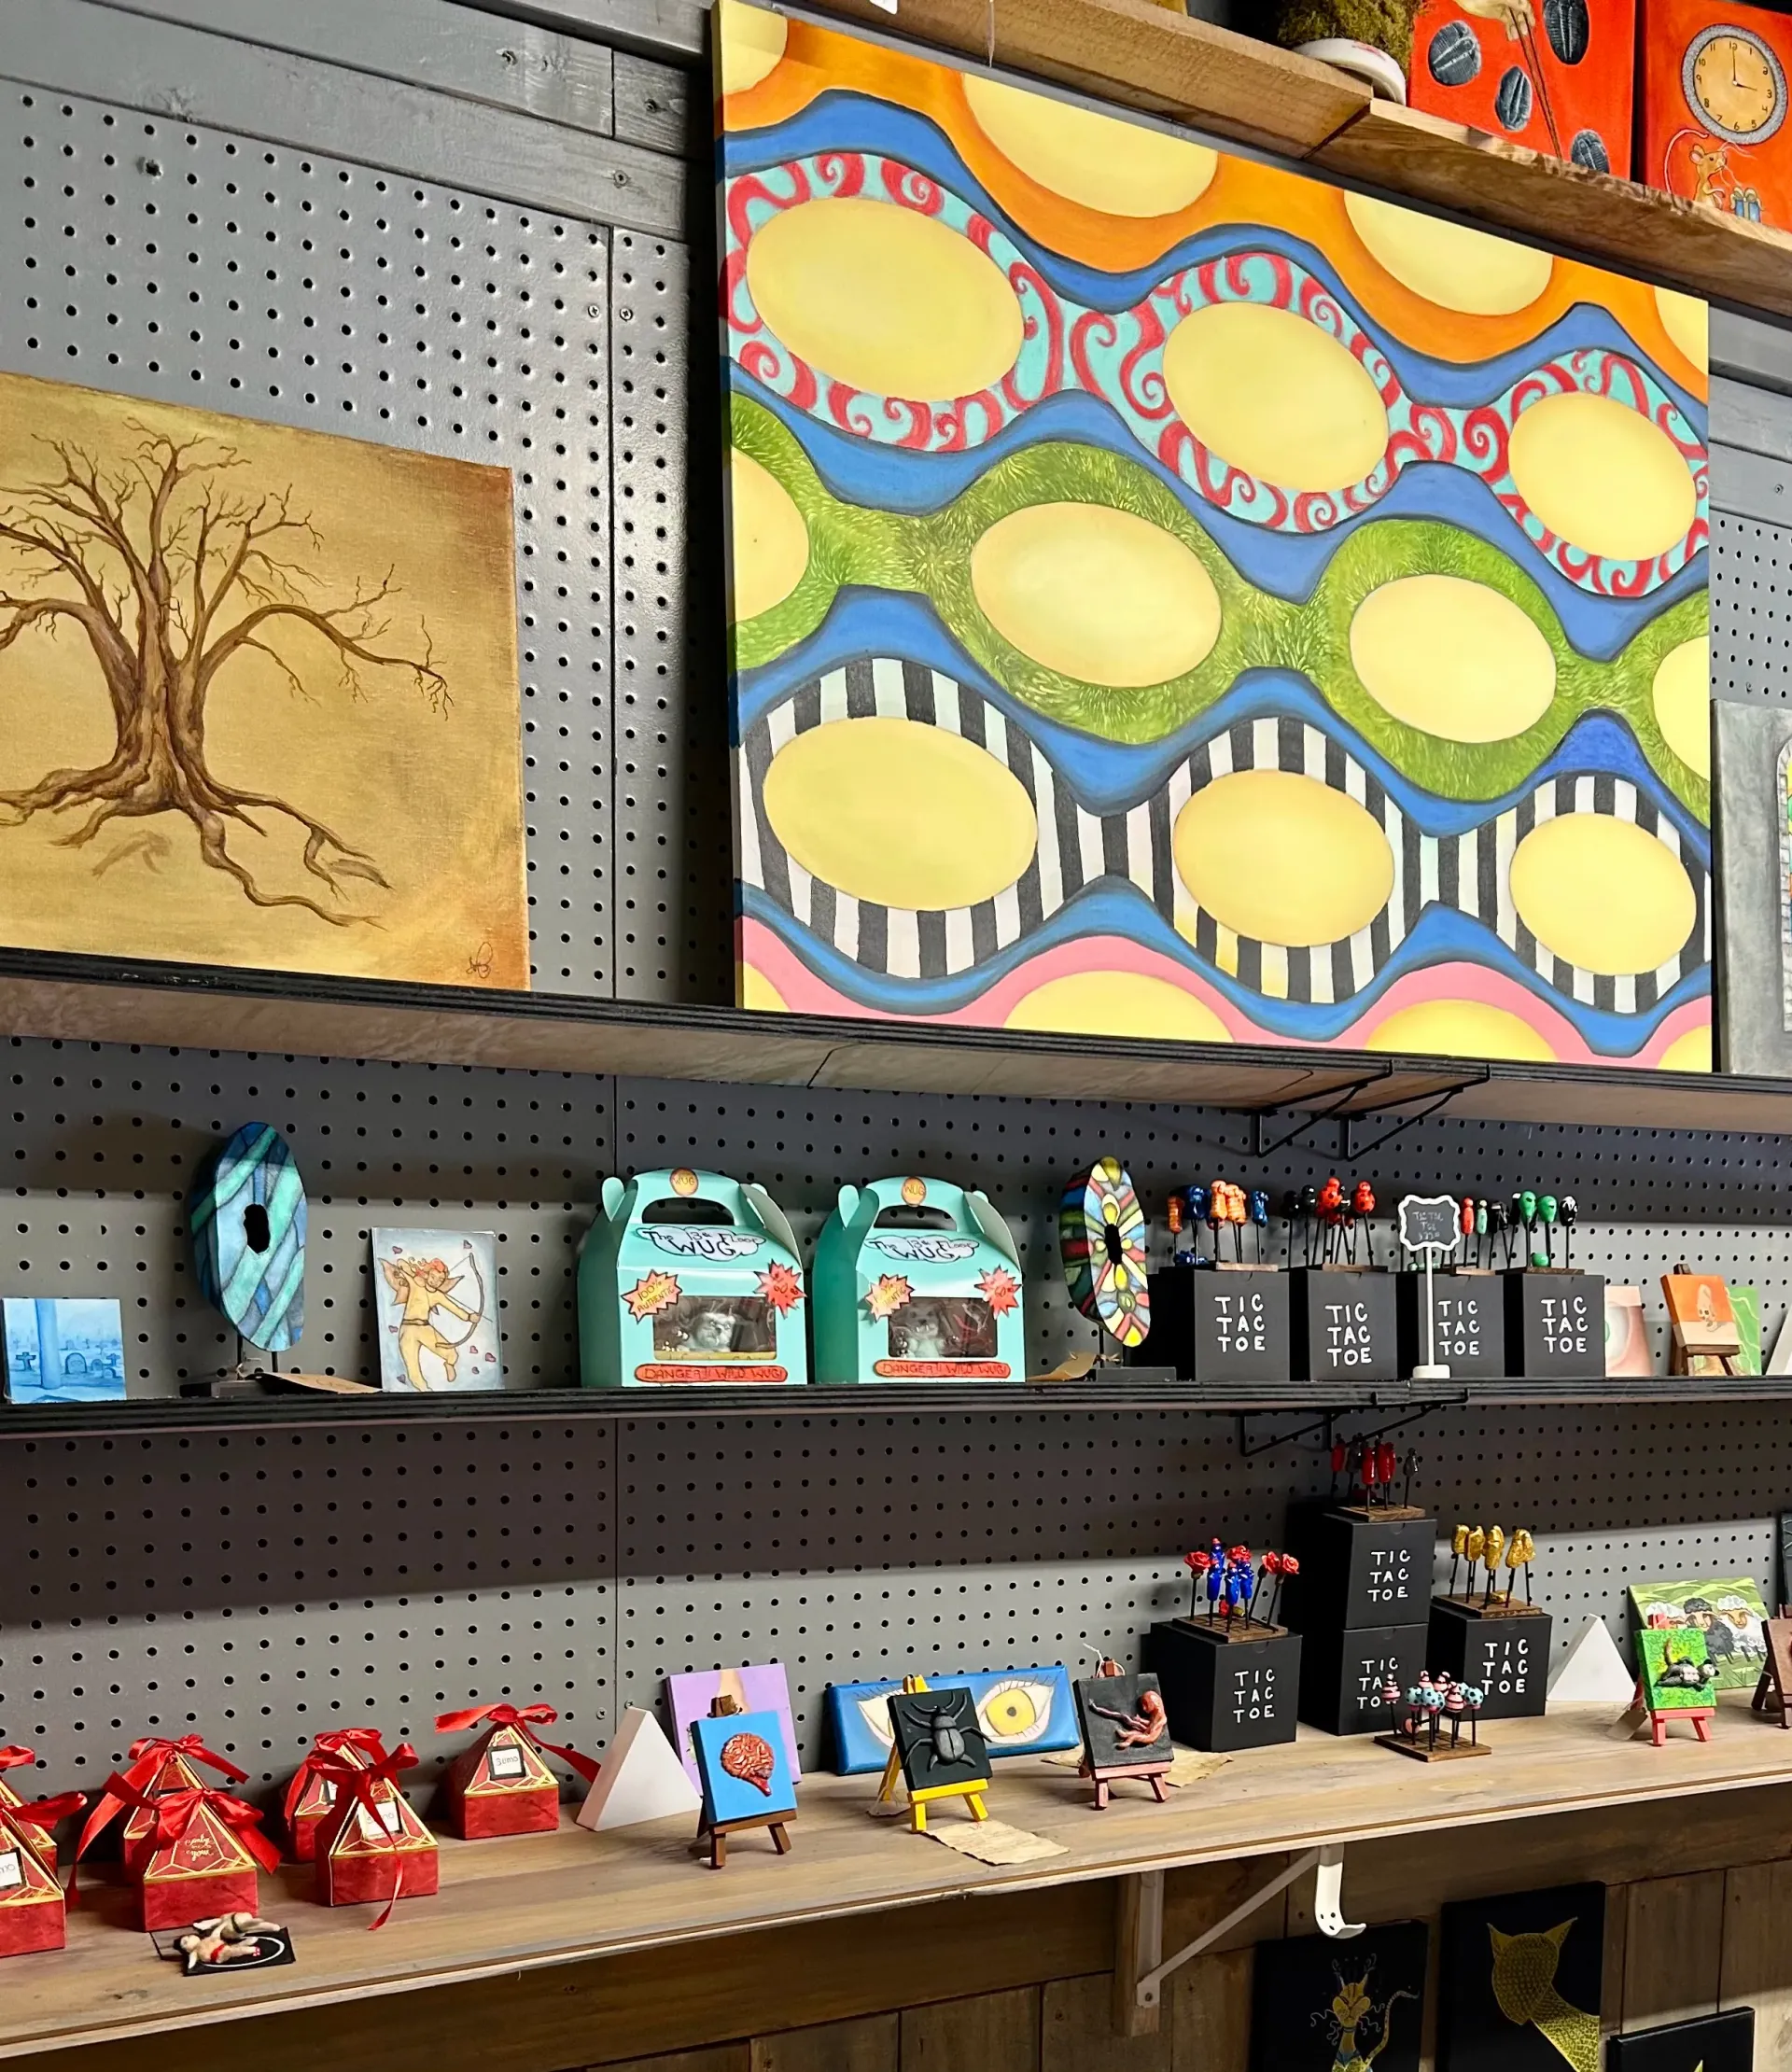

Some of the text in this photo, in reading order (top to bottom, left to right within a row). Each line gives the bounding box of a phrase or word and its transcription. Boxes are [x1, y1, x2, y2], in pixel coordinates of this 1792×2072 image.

[1699, 58, 1706, 66] 10
[1696, 74, 1701, 84] 9
[1767, 89, 1772, 98] 3
[1704, 98, 1709, 108] 8
[1761, 105, 1768, 114] 4
[1733, 121, 1740, 131] 6
[1751, 119, 1757, 128] 5
[674, 1177, 695, 1186] WUG
[904, 1184, 925, 1195] WUG
[642, 1231, 674, 1240] The
[668, 1239, 736, 1256] WUG
[893, 1248, 956, 1260] WUG
[637, 1279, 662, 1301] 100%
[637, 1285, 674, 1312] AUTHENTIC
[1214, 1294, 1264, 1314] TIC
[1437, 1299, 1478, 1317] TIC
[1540, 1296, 1587, 1317] TIC
[1324, 1302, 1368, 1324] TIC
[1215, 1315, 1266, 1335] TAC
[1437, 1319, 1480, 1337] TAC
[1542, 1316, 1589, 1336] TAC
[1326, 1325, 1371, 1346] TAC
[1217, 1336, 1266, 1353] TOE
[1438, 1340, 1480, 1356] TOE
[1543, 1337, 1587, 1353] TOE
[1326, 1347, 1372, 1367] TOE
[715, 1368, 746, 1379] WILD
[945, 1364, 973, 1374] WILD
[1371, 1549, 1411, 1566] TIC
[1369, 1568, 1409, 1584] TAC
[1367, 1586, 1408, 1603] TOE
[1484, 1638, 1529, 1659] TIC
[1361, 1657, 1398, 1674] TIC
[1482, 1659, 1528, 1677] TAC
[1234, 1669, 1275, 1687] TIC
[1233, 1686, 1274, 1705] TAC
[1481, 1678, 1525, 1696] TOE
[1232, 1704, 1275, 1724] TOE
